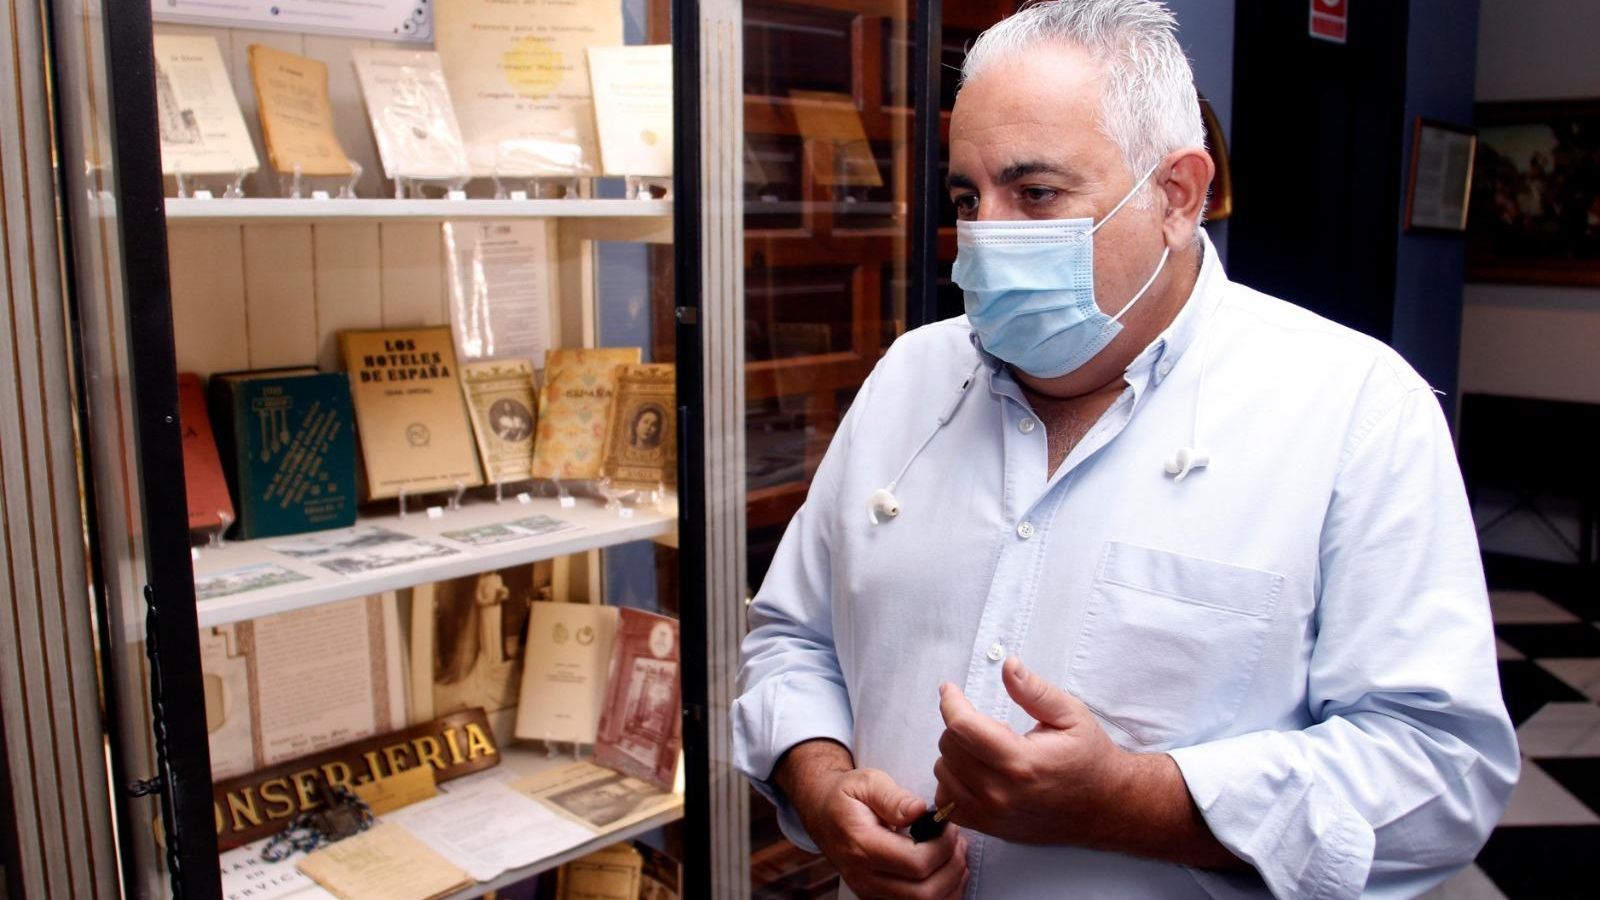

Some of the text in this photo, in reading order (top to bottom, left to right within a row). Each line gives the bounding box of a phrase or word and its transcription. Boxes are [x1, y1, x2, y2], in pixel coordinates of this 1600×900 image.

[385, 339, 415, 353] LOS
[363, 351, 442, 368] HOTELES
[360, 369, 382, 384] DE
[387, 364, 450, 382] ESPAÑA
